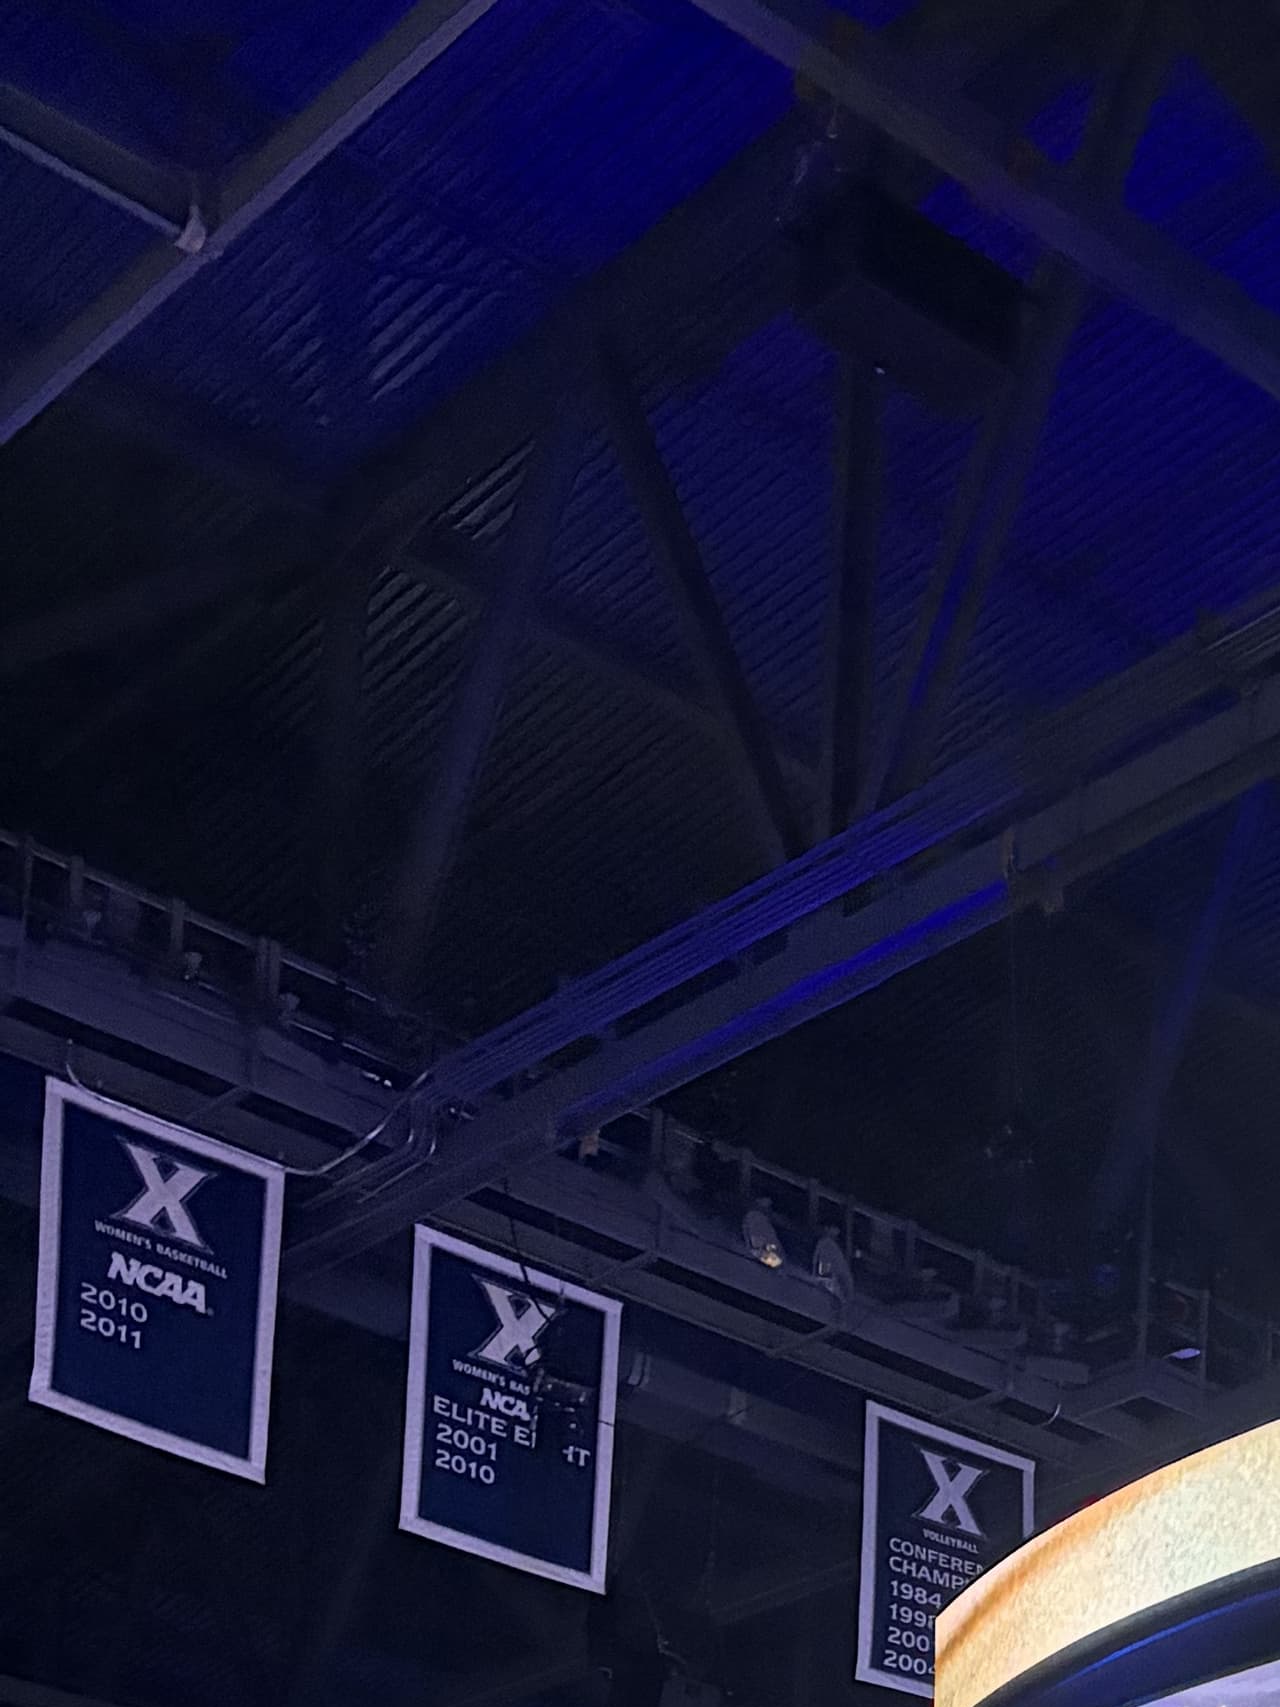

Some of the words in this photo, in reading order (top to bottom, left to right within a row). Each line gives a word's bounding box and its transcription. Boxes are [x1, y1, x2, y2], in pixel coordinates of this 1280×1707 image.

[94, 1219, 151, 1249] WOMEN'S
[155, 1244, 228, 1280] BASKETBALL
[107, 1252, 208, 1314] NCAA
[80, 1281, 148, 1323] 2010
[79, 1309, 142, 1350] 2011
[452, 1359, 506, 1388] WOMEN'S
[433, 1394, 508, 1438] ELITE
[479, 1387, 531, 1421] NCA
[436, 1422, 498, 1461] 2001
[434, 1449, 496, 1485] 2010
[888, 1536, 984, 1576] CONFEREN
[923, 1527, 980, 1554] VOLLEYBALL
[888, 1555, 970, 1591] CHAMP
[890, 1579, 942, 1609] 1984
[887, 1625, 931, 1653] 200
